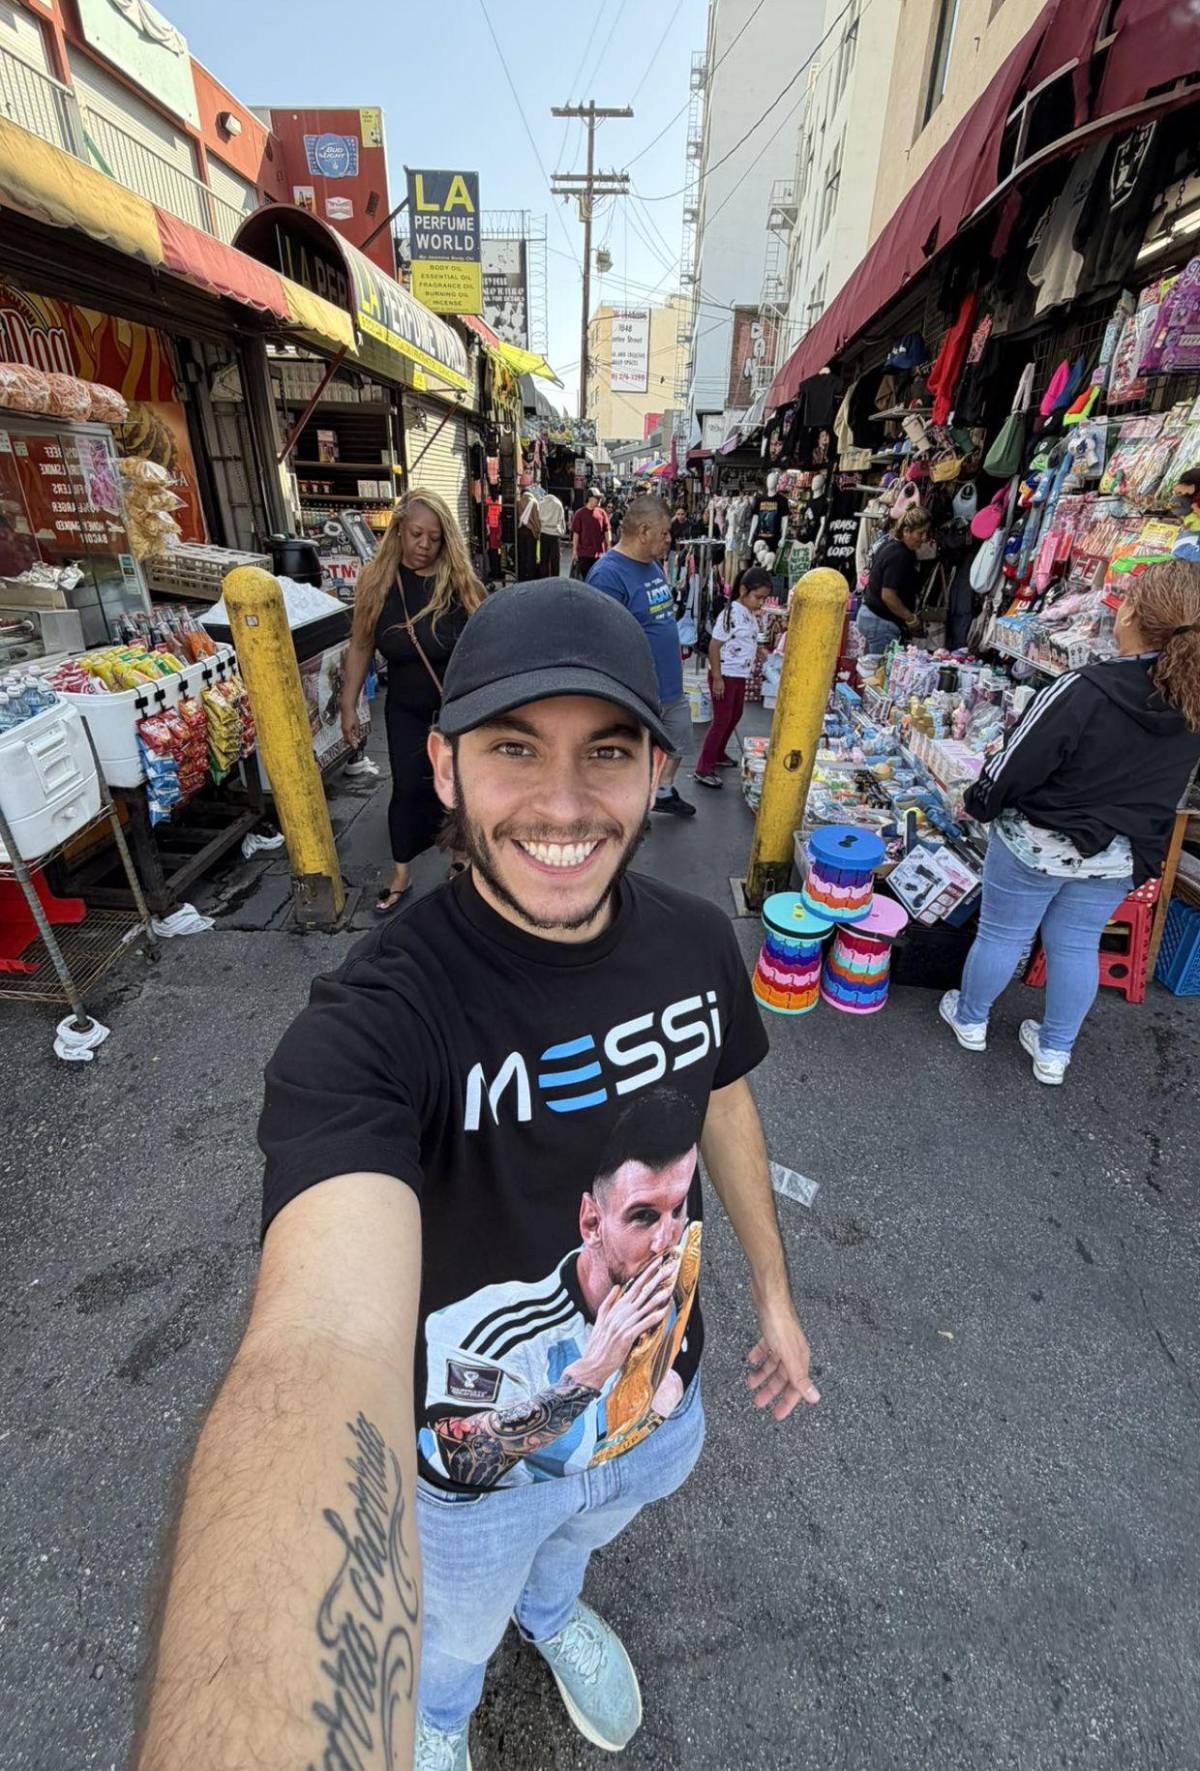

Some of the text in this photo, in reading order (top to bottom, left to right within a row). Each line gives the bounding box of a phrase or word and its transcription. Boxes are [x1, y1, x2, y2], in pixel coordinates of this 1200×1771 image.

[415, 174, 476, 213] LA
[414, 215, 475, 232] PERFUME
[415, 233, 475, 251] WORLD
[829, 520, 858, 532] PRAISE
[832, 533, 852, 546] THE
[827, 546, 855, 558] LORD
